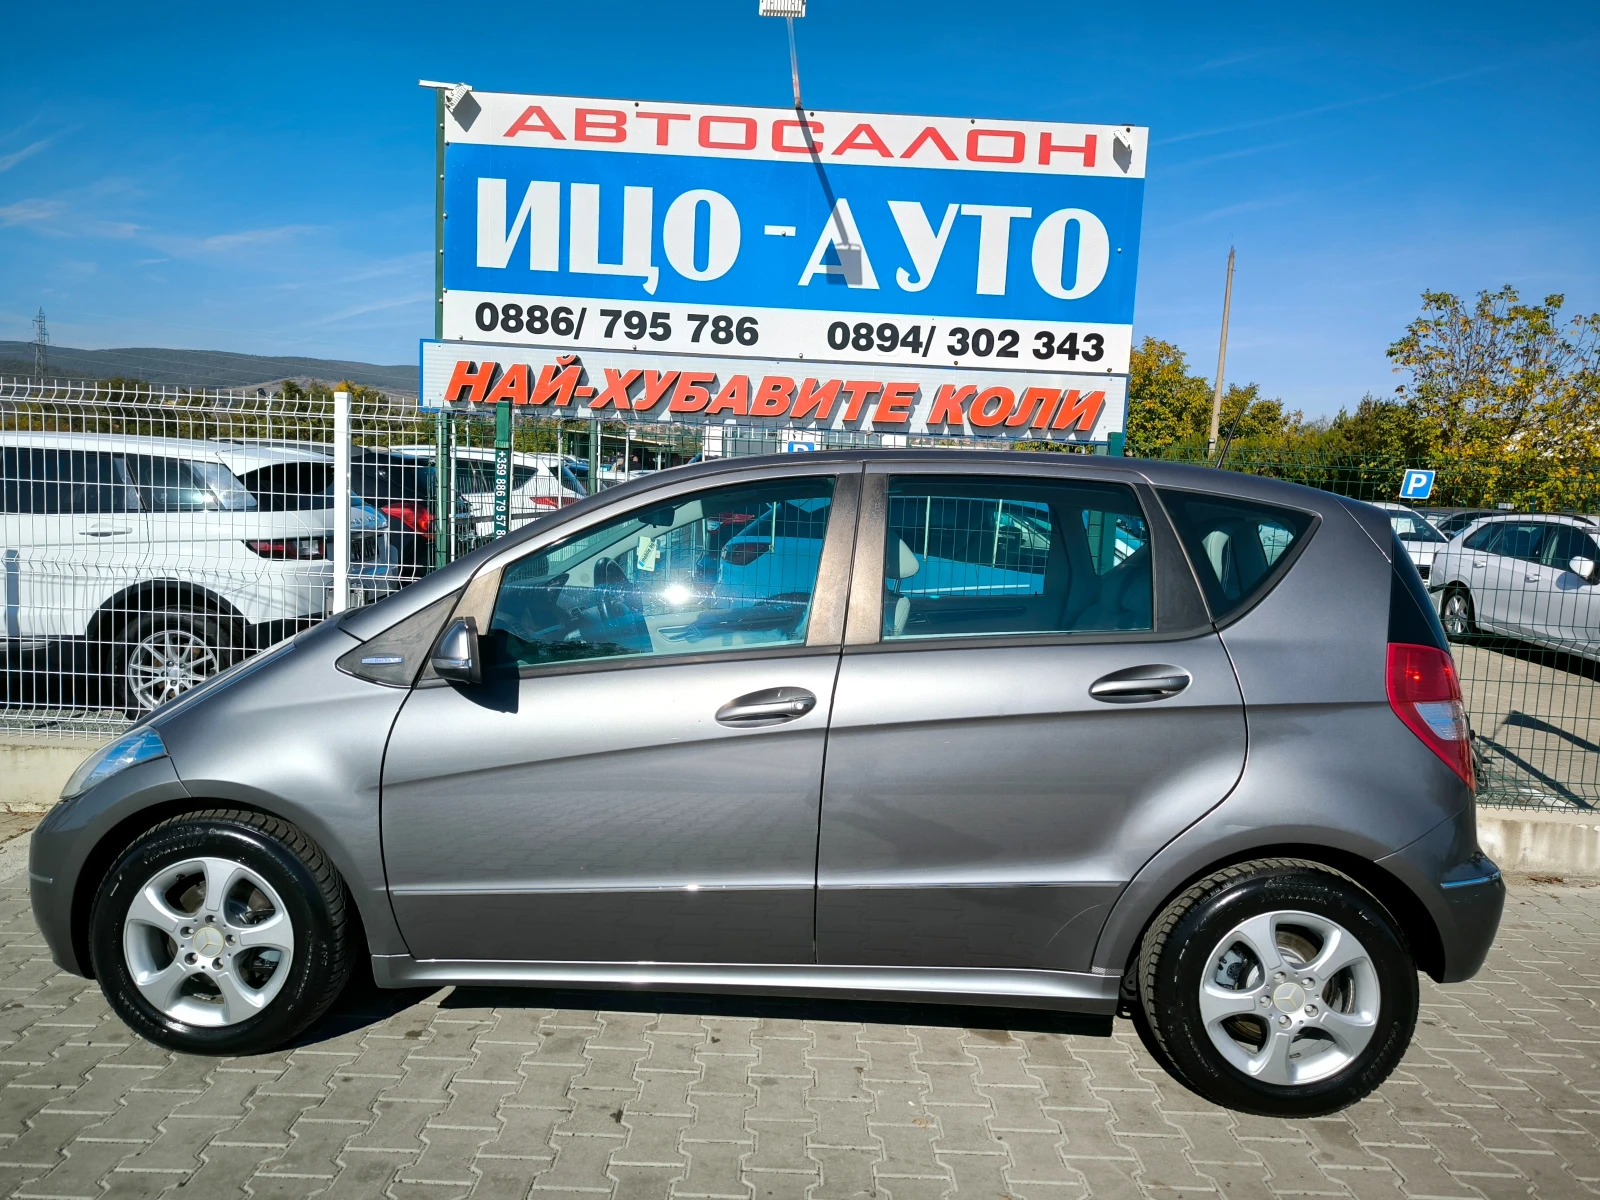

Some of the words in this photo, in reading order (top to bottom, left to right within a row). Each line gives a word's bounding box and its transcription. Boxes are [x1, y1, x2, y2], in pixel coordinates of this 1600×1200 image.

[504, 105, 1099, 168] АВТОСАЛОН
[476, 177, 741, 296] ИЦО
[797, 197, 1110, 300] АУТО
[475, 301, 587, 340] 0886/
[599, 308, 673, 342] 795
[687, 313, 760, 346] 786
[827, 321, 936, 358] 0894/
[947, 327, 1021, 359] 302
[1033, 331, 1105, 362] 343
[444, 356, 919, 422] НАЙ-ХУБАВИТЕ
[929, 384, 1106, 431] КОЛИ
[497, 450, 508, 476] +359
[495, 479, 507, 497] 886
[1407, 473, 1427, 495] P
[495, 500, 507, 512] 79
[495, 515, 507, 527] 57
